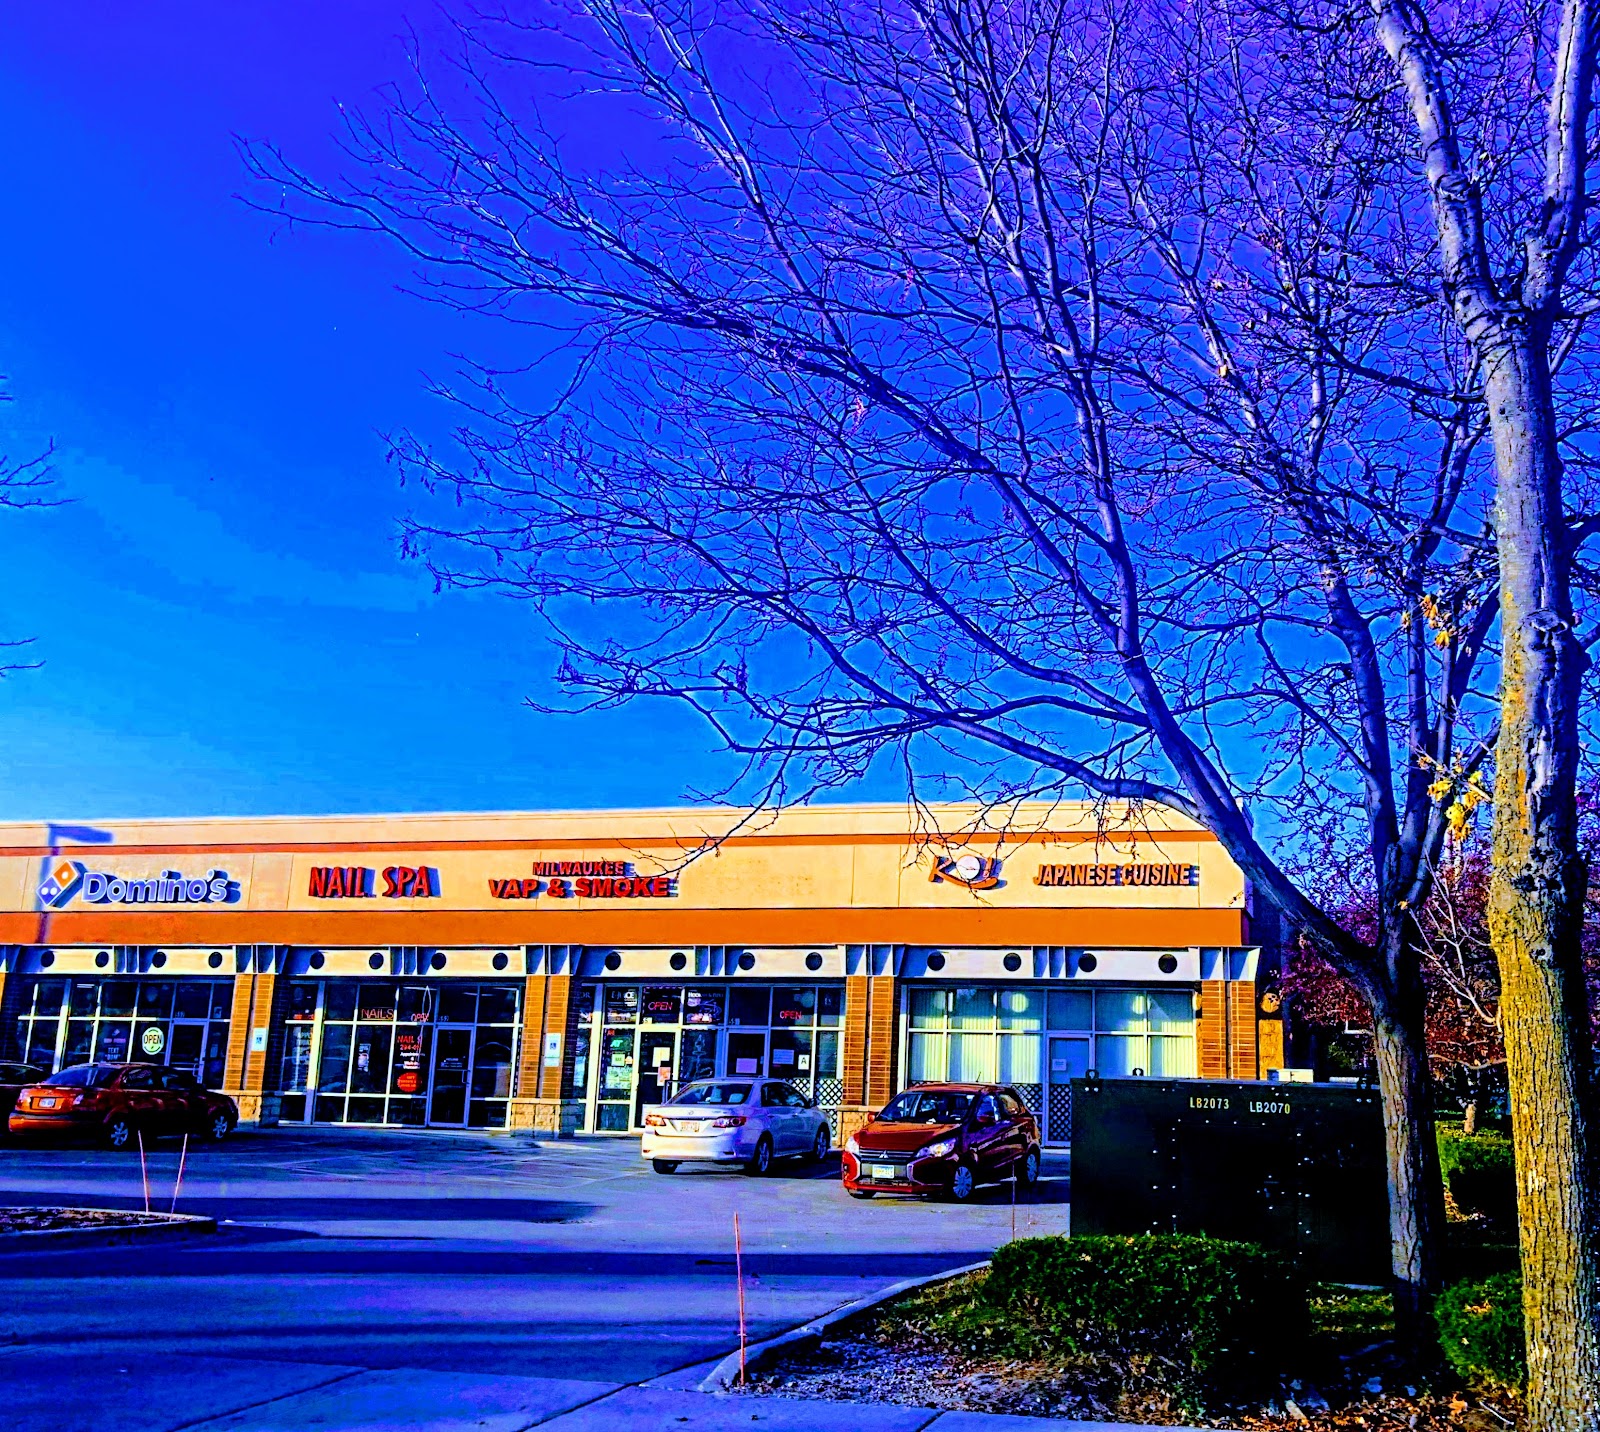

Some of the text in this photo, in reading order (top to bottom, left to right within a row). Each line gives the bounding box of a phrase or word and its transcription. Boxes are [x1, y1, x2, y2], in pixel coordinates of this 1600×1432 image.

[533, 861, 625, 877] MILWAUKEE
[1033, 863, 1192, 887] JAPANESE CUISINE
[81, 869, 229, 903] Domino's
[308, 866, 431, 898] NAIL SPA
[488, 877, 671, 899] VAP & SMOKE
[648, 1001, 673, 1011] OPEN
[779, 1010, 802, 1020] OPEN
[143, 1034, 162, 1045] OPEN
[397, 1035, 415, 1044] NAIL
[1190, 1096, 1230, 1110] LB2073
[1249, 1101, 1291, 1115] LB2070
